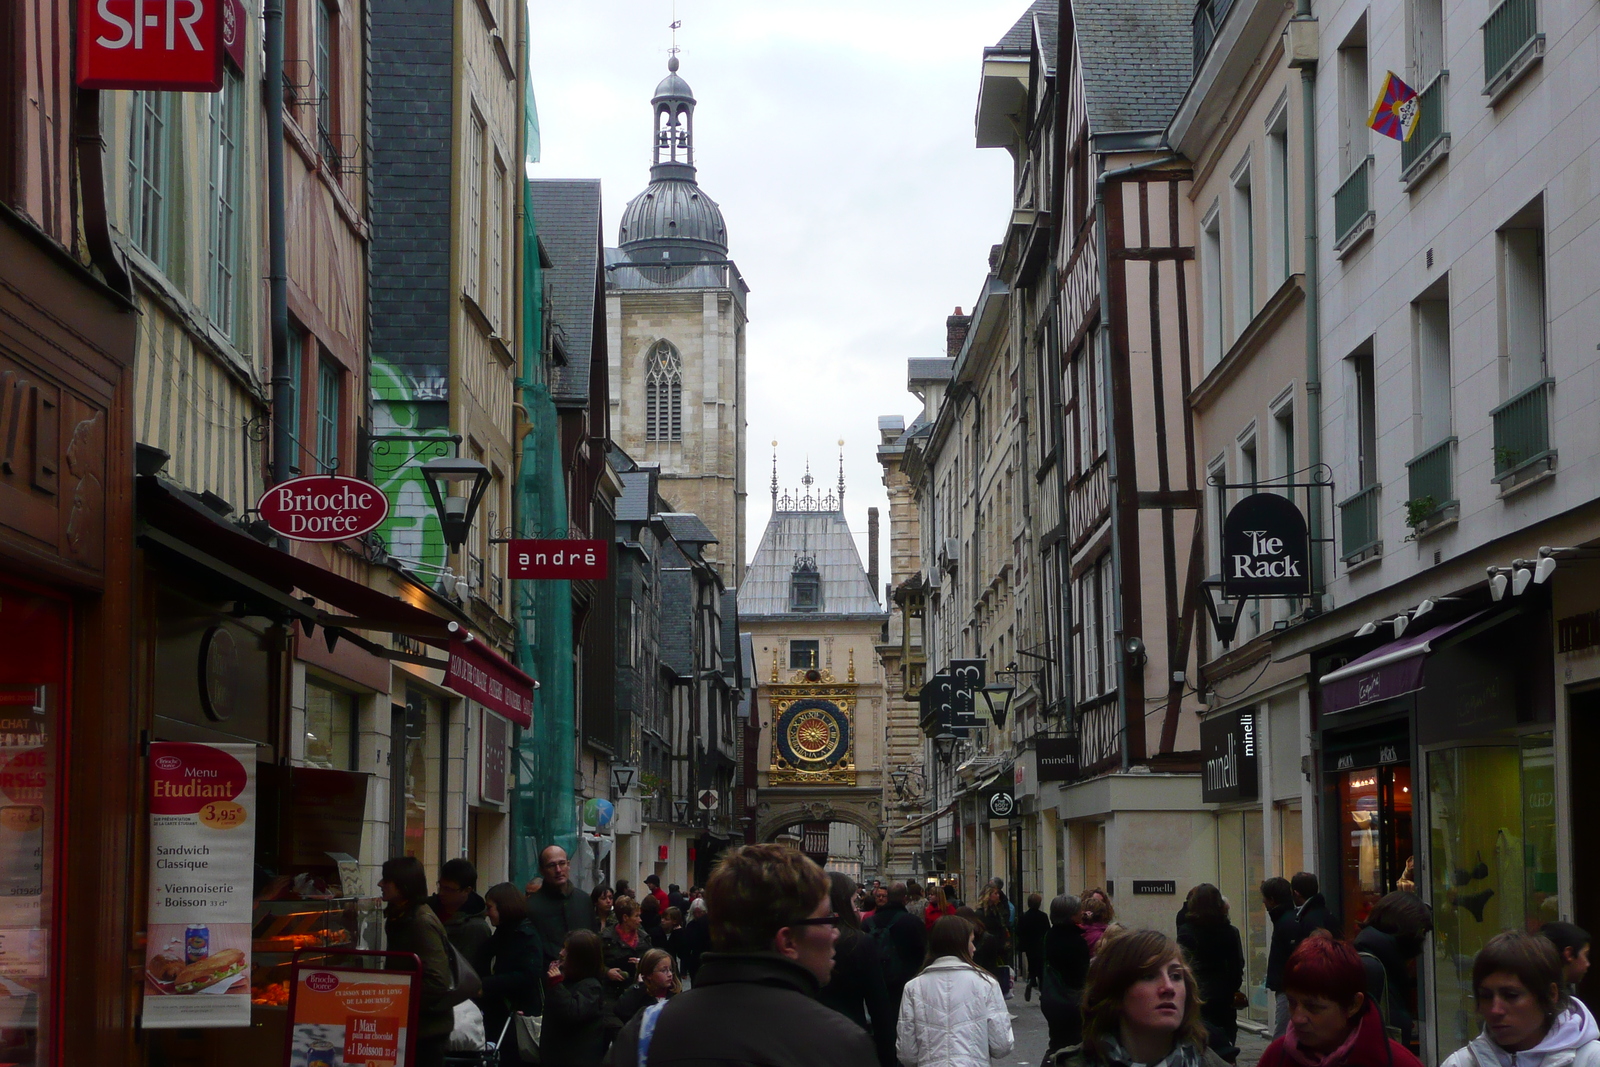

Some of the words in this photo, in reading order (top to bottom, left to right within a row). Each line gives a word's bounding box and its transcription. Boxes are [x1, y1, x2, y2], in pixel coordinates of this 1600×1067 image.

[95, 0, 205, 51] SFR
[277, 485, 373, 512] Brioche
[289, 510, 358, 533] Dorée
[1242, 530, 1284, 557] Tie
[1231, 554, 1302, 579] Rack
[1240, 714, 1254, 757] minelli
[1041, 754, 1075, 765] minelli
[1207, 732, 1238, 791] minelli
[184, 767, 218, 777] Menu
[153, 778, 233, 798] Etudiant
[156, 844, 210, 855] Sandwich
[156, 858, 208, 871] Classique
[164, 883, 234, 893] Viennoiserie
[1141, 883, 1173, 893] minelli
[165, 897, 207, 907] Boisson
[310, 974, 336, 984] Brioche
[364, 996, 391, 1004] JOURNÉE
[359, 1019, 377, 1032] Maxi
[352, 1032, 364, 1041] pain
[371, 1032, 394, 1041] chocolat
[357, 1042, 384, 1057] Boisson
